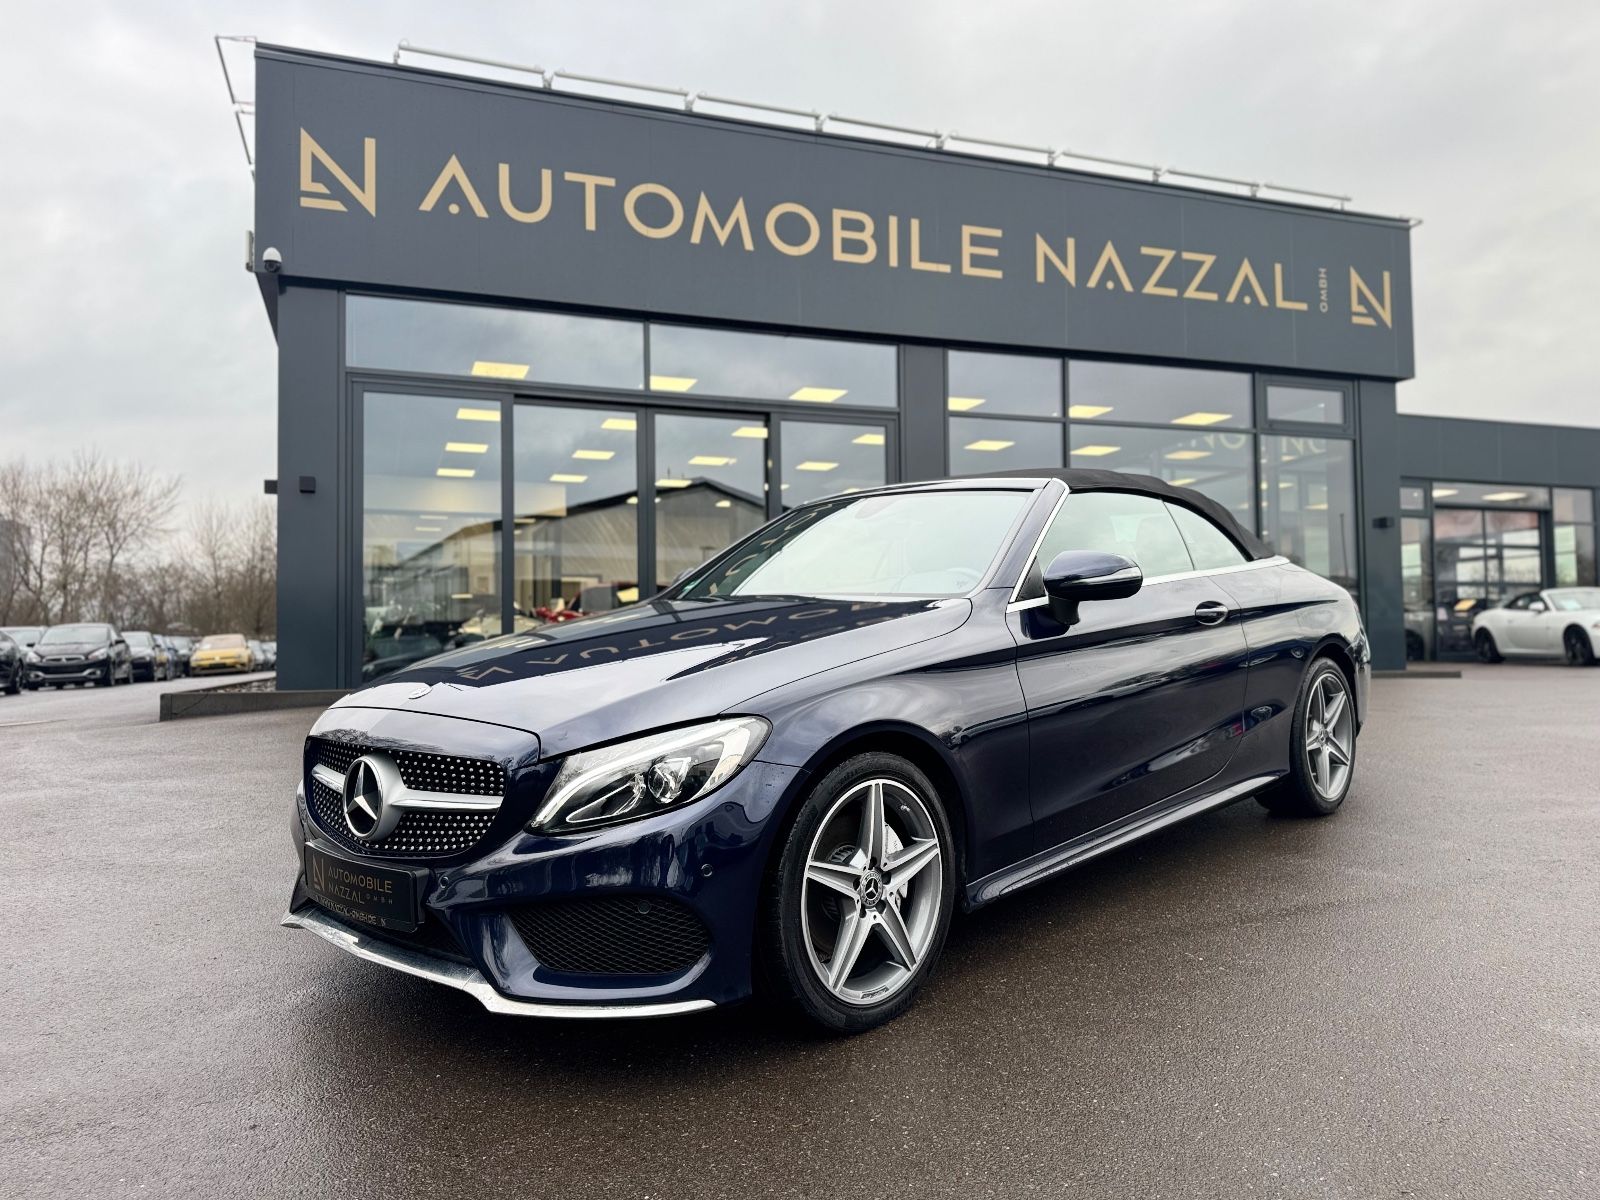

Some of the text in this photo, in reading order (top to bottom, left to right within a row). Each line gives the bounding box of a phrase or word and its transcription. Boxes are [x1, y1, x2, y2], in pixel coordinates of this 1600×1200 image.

[420, 156, 1003, 278] AUTOMOBILE
[1035, 234, 1308, 311] NAZZAL
[328, 866, 393, 893] AUTOMOBILE
[328, 882, 365, 904] NAZZAL
